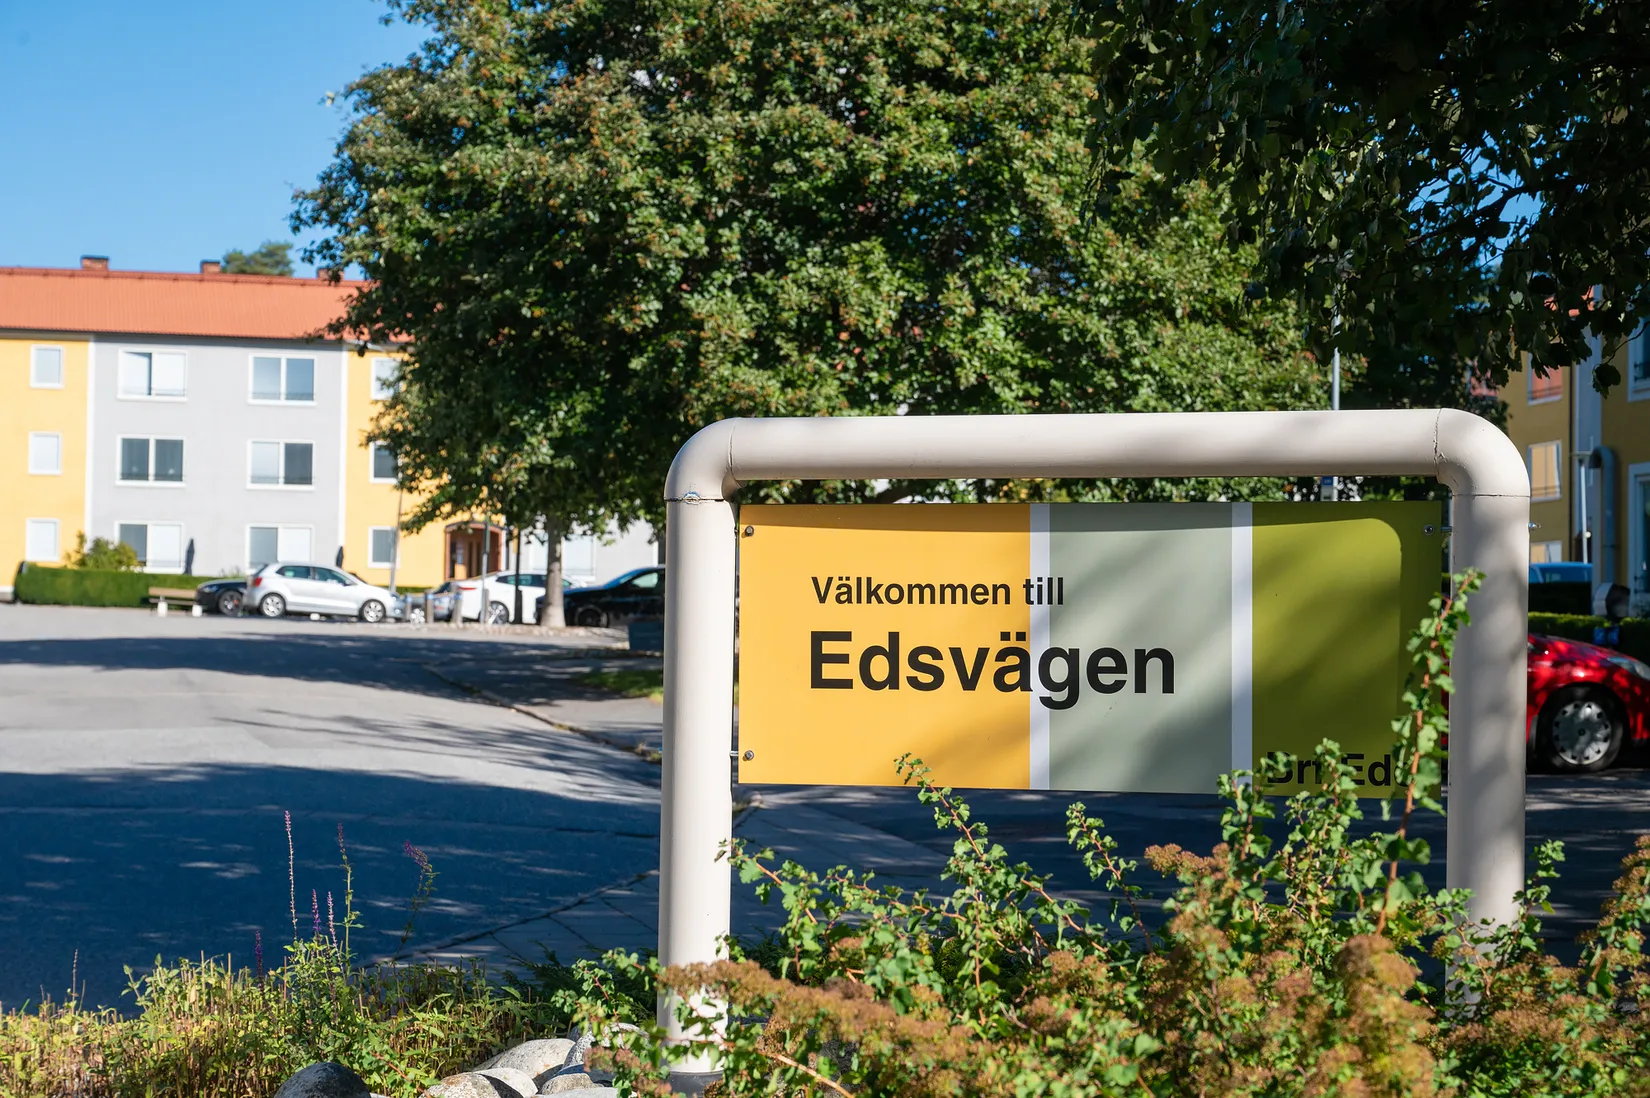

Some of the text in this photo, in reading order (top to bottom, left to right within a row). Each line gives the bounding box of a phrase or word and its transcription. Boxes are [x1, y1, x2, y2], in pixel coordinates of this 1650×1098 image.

[811, 576, 1065, 606] Välkommen till
[810, 630, 1175, 710] Edsvägen
